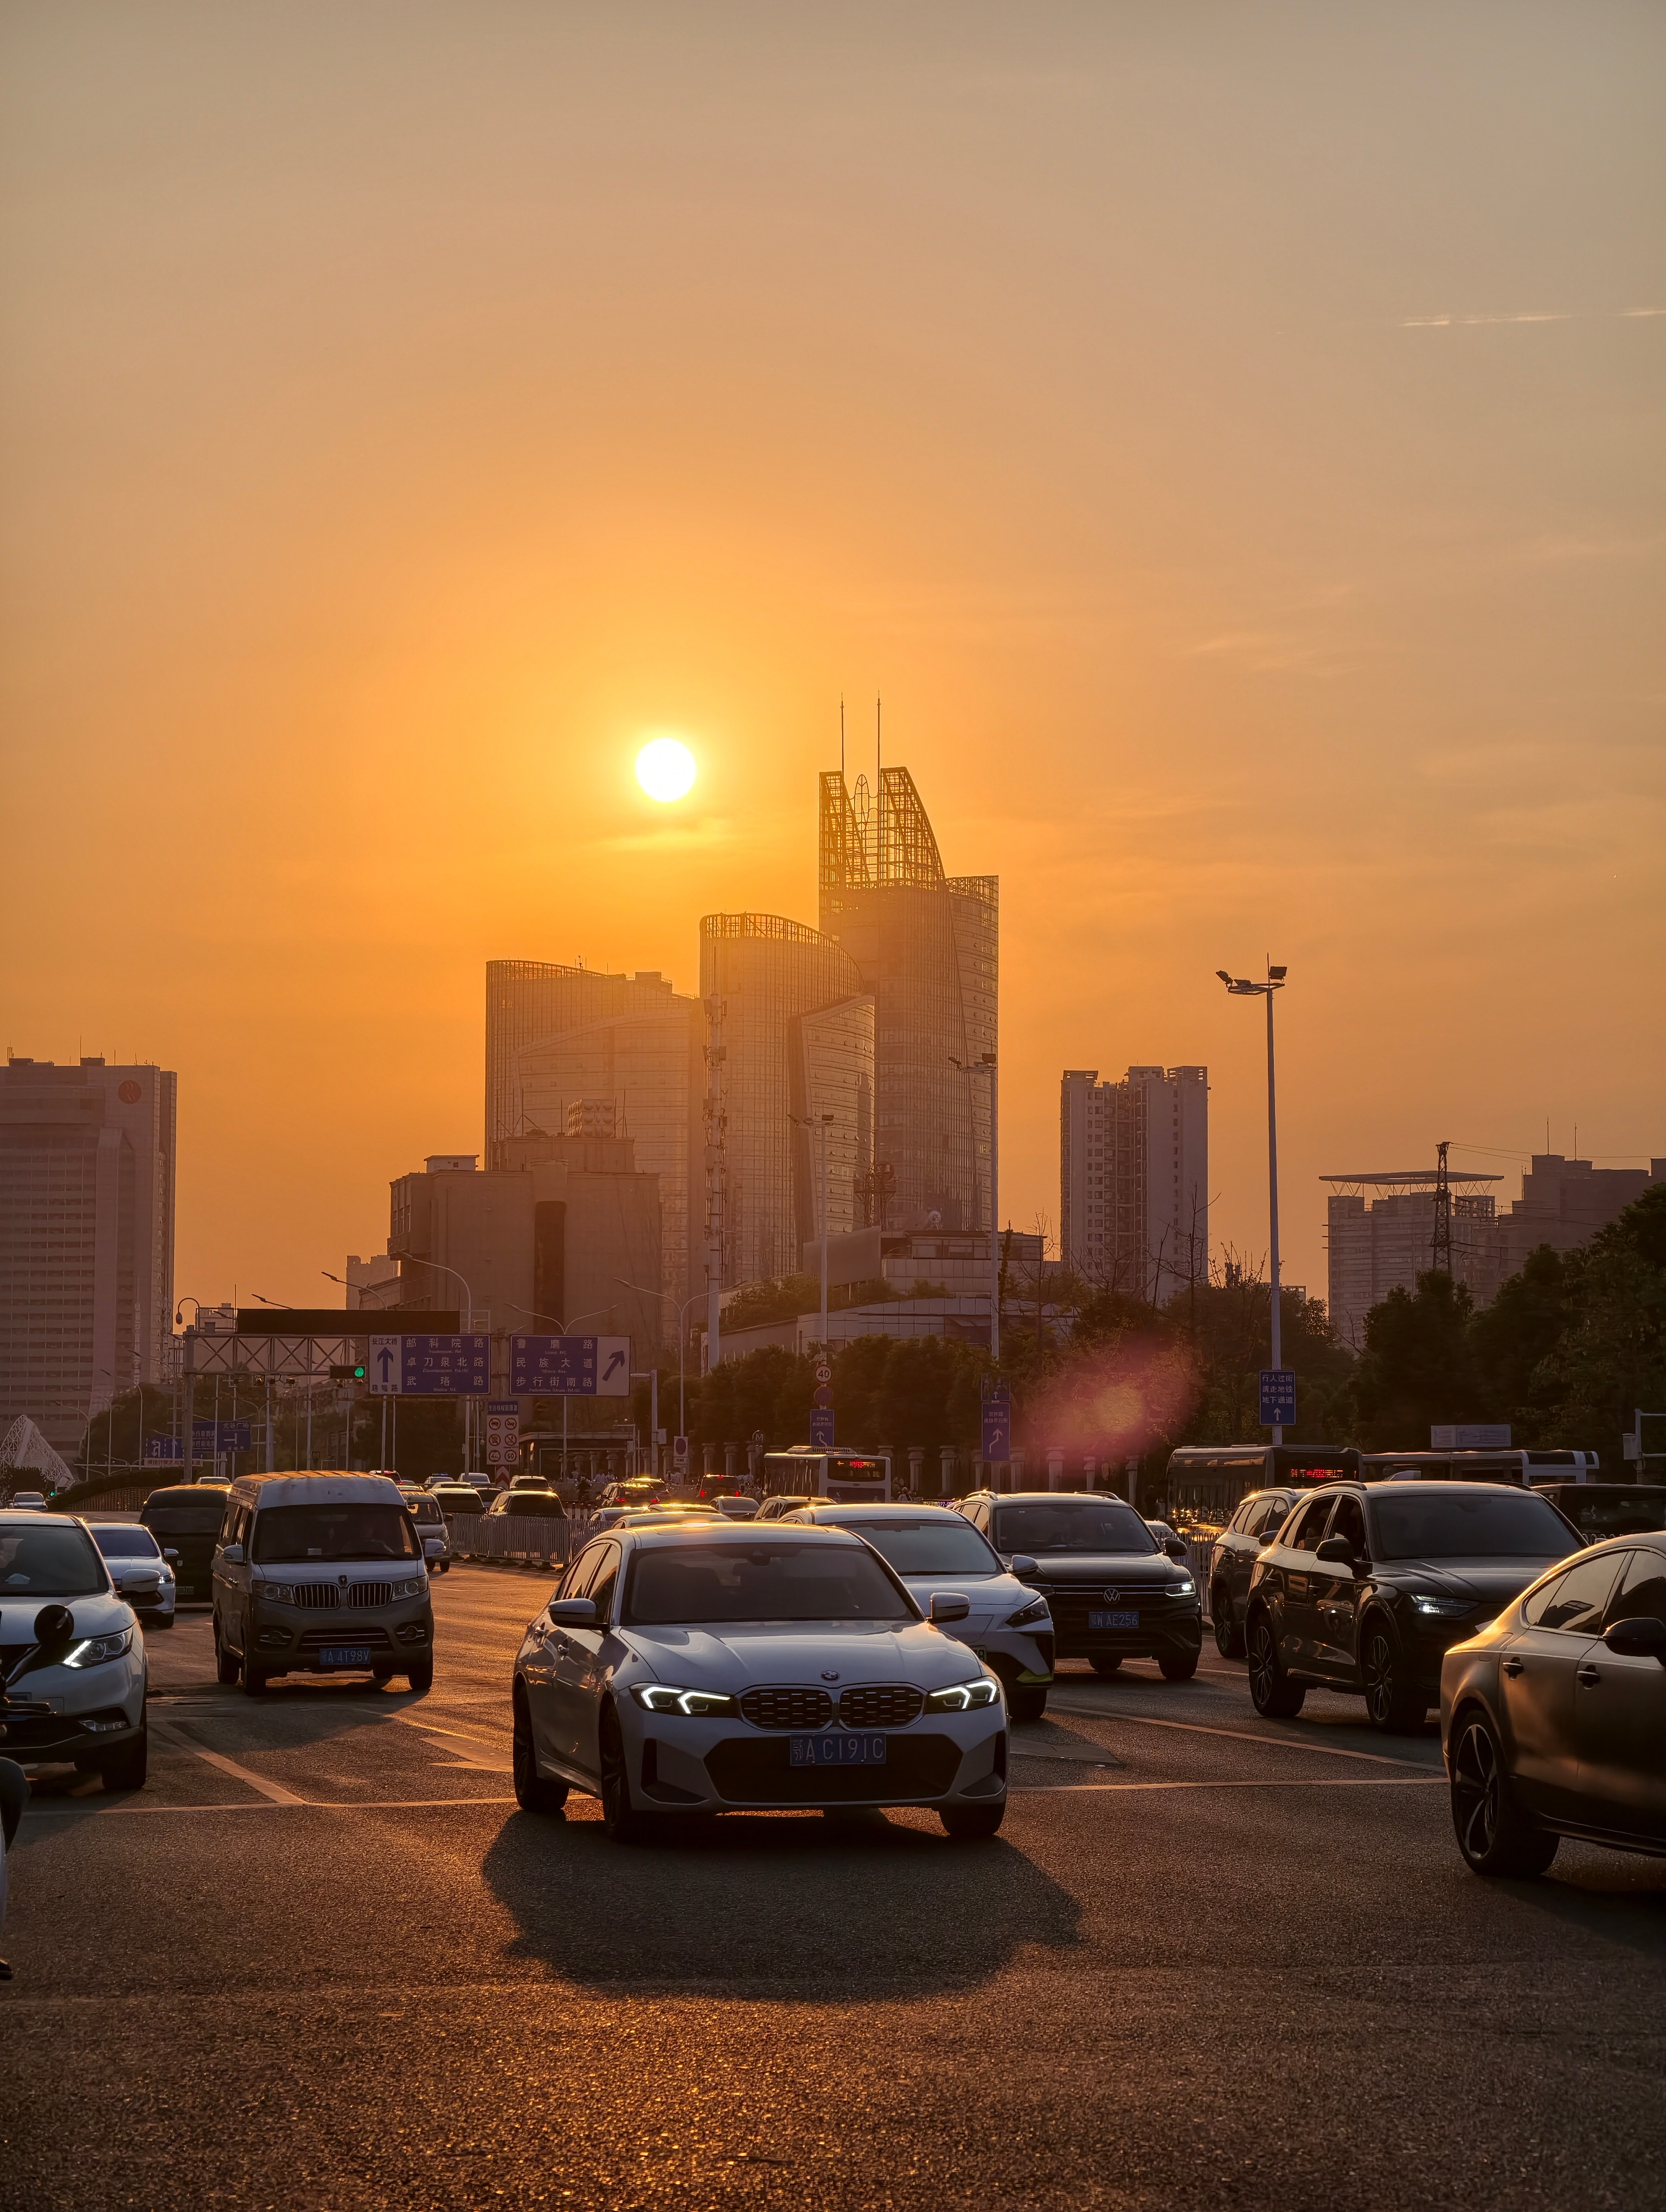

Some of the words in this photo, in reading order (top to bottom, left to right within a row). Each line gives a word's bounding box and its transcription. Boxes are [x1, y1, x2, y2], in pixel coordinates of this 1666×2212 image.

[407, 1338, 484, 1348] 邮科院路
[407, 1357, 484, 1367] 卓刀泉北路
[516, 1358, 593, 1368] 民族大道
[818, 1369, 830, 1378] 40
[1262, 1374, 1293, 1382] 行人过街
[407, 1376, 484, 1386] 武珞路
[516, 1377, 593, 1387] 步行街南路
